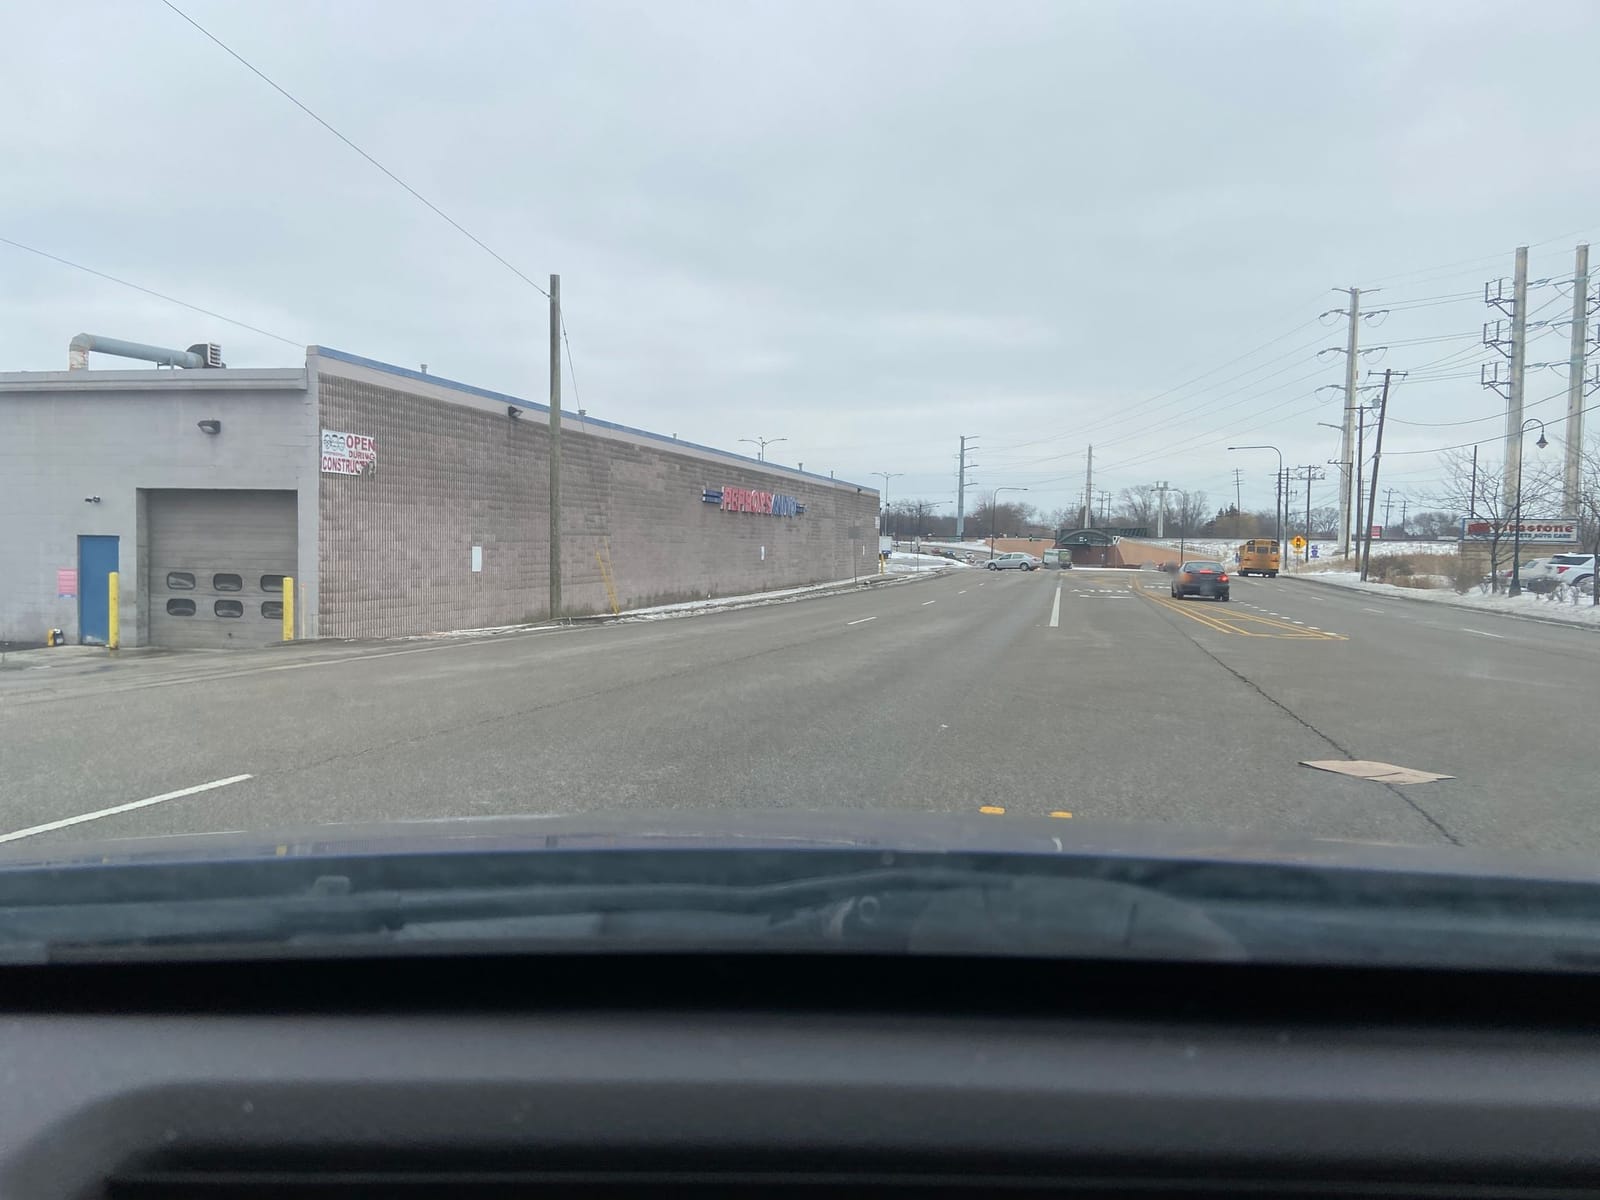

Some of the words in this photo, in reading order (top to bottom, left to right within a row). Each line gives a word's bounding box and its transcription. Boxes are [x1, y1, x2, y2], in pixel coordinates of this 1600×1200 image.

[346, 435, 375, 452] OPEN
[348, 450, 375, 460] DURING
[322, 456, 368, 474] CONSTRUC
[1494, 523, 1573, 533] irestone
